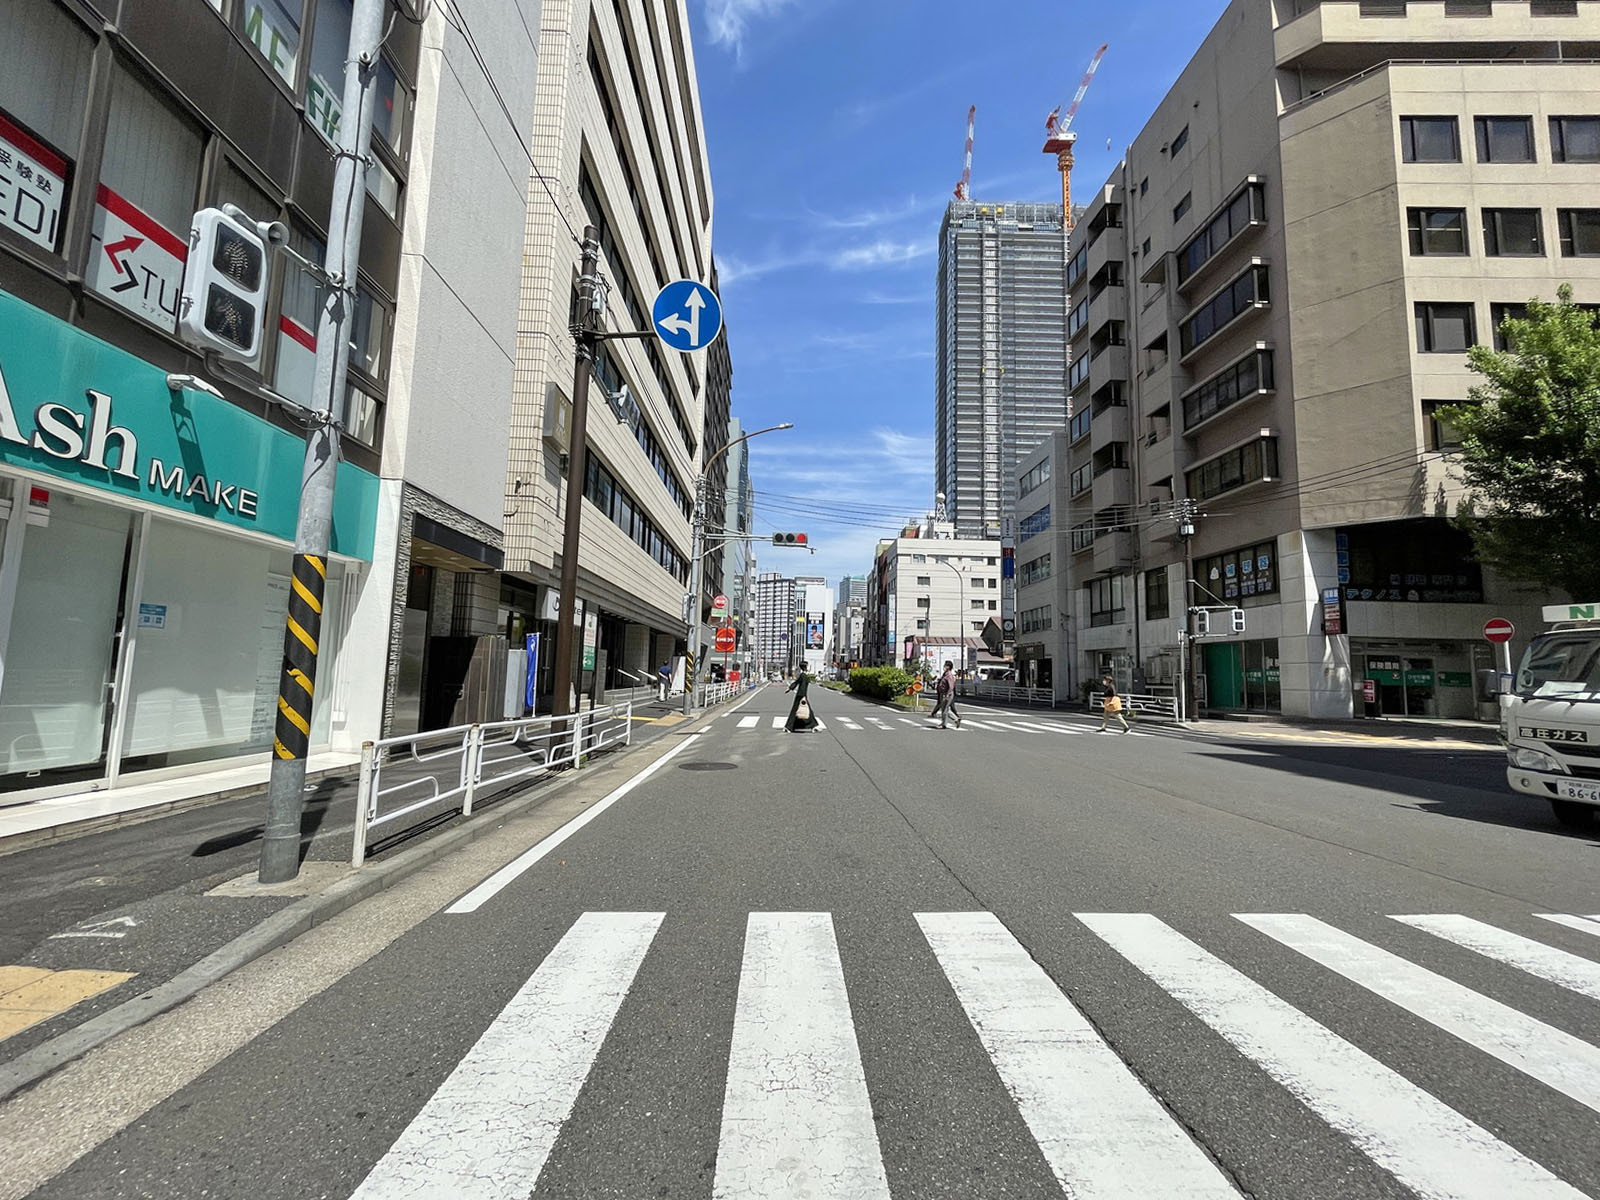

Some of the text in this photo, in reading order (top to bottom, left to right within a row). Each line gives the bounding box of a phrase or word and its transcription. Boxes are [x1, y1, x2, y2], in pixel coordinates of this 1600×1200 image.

[149, 458, 259, 517] MAKE
[1569, 605, 1595, 619] N
[1520, 728, 1585, 742] 高圧ガス
[1568, 788, 1600, 802] 86-6
